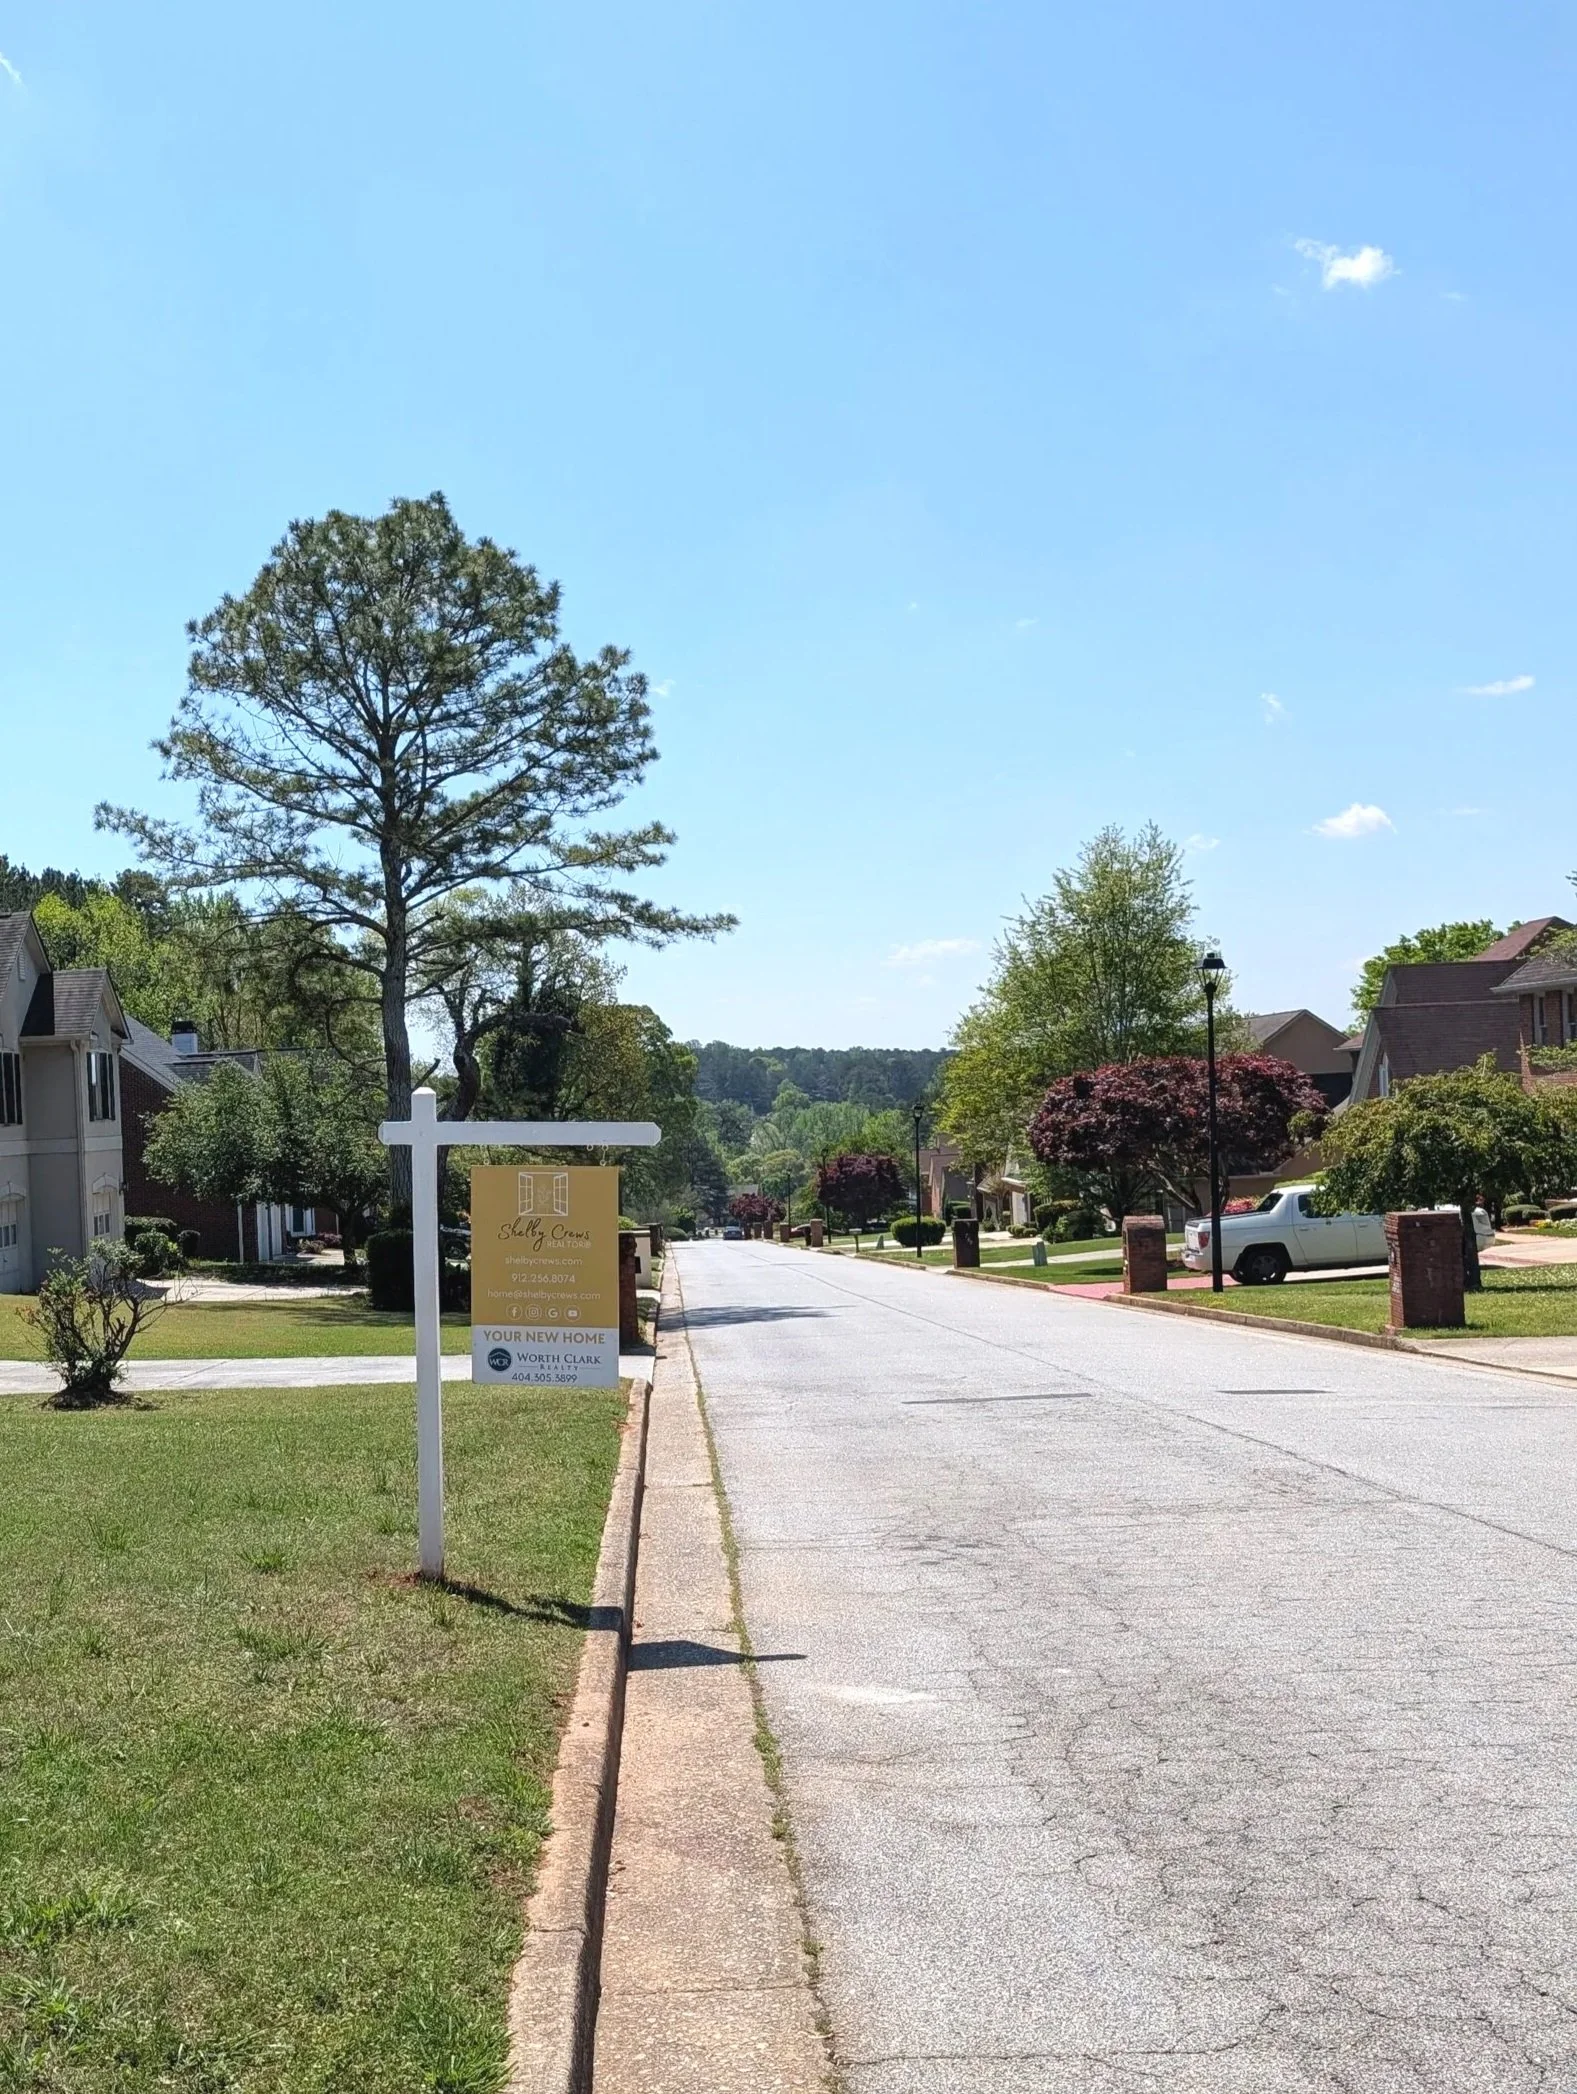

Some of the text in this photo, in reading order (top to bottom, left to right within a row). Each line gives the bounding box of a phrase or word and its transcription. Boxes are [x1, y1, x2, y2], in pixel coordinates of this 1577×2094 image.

[498, 1217, 591, 1252] Shelby Crews
[504, 1255, 583, 1267] shelbycrews.com
[511, 1272, 576, 1284] 912.256.8074
[487, 1288, 601, 1301] home@shelbycrews.com
[483, 1330, 605, 1344] YOUR NEW HOME
